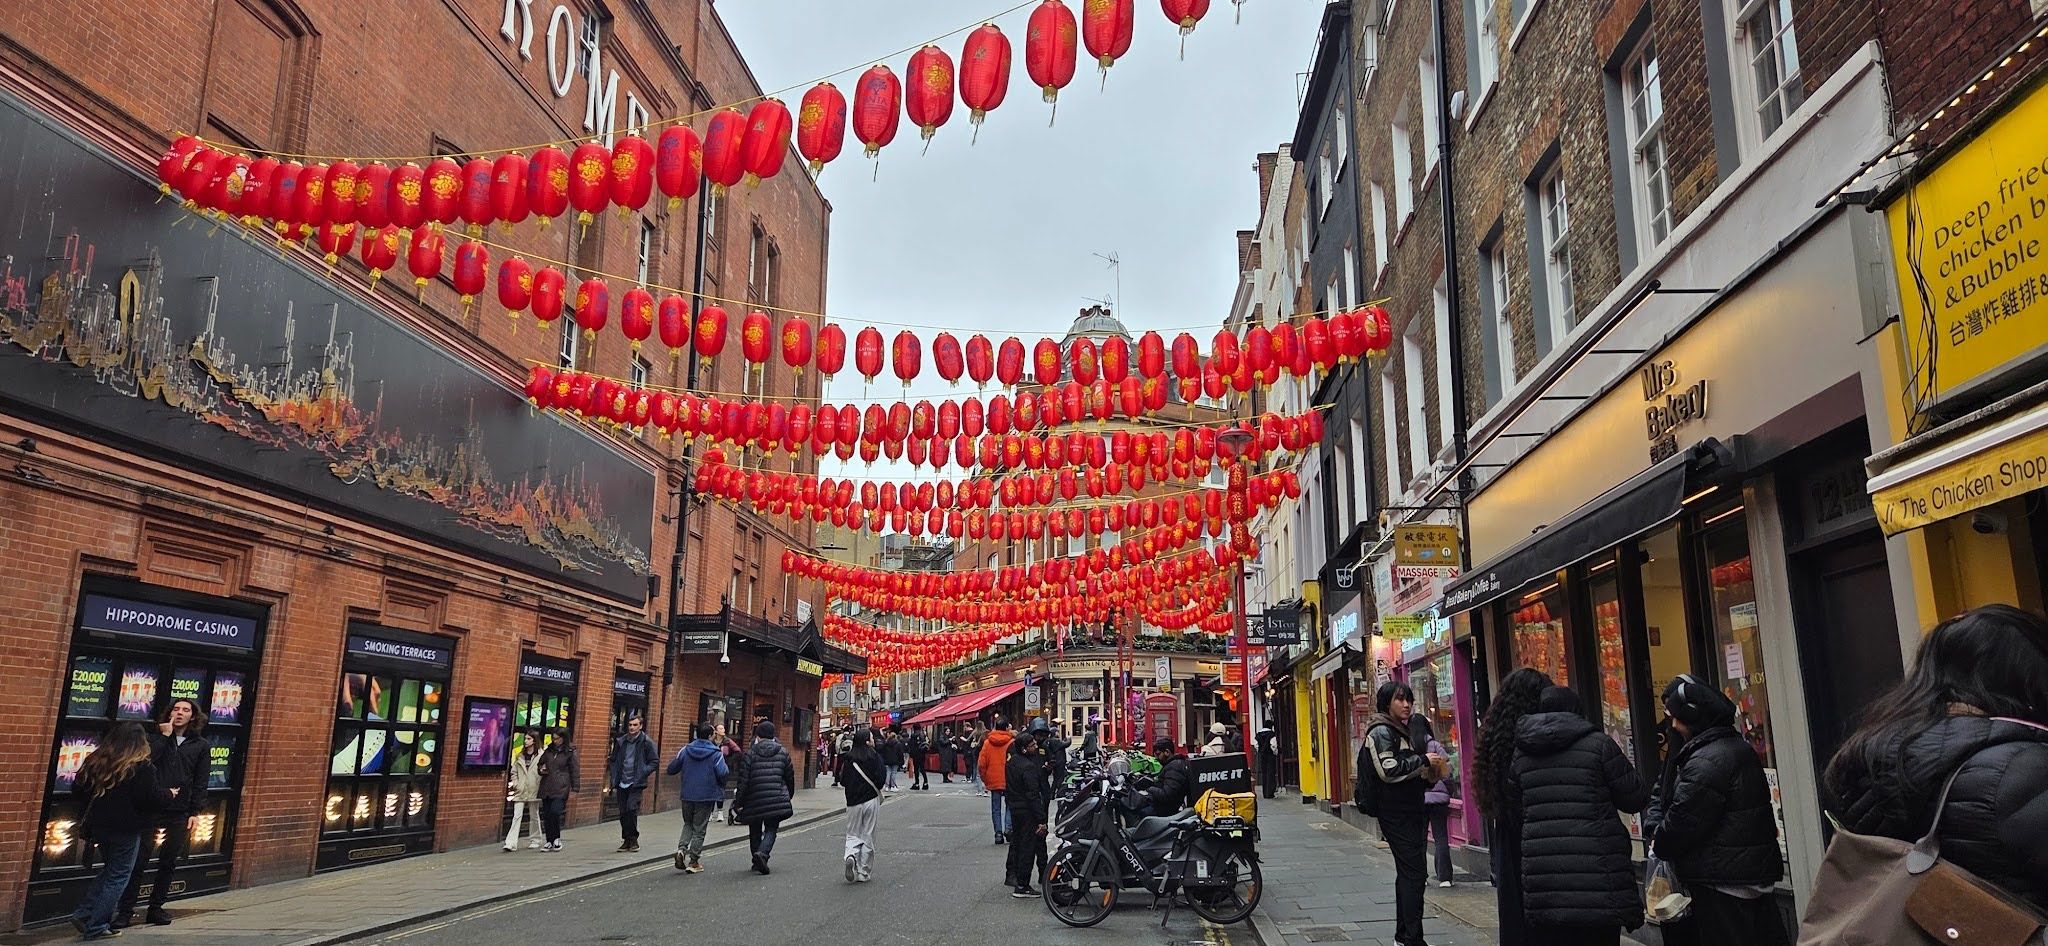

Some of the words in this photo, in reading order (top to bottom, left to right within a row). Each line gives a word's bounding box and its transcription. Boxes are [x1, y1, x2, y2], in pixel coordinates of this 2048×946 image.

[1934, 200, 1990, 250] Deep
[1940, 213, 2023, 278] chicken
[1944, 239, 2040, 309] &Bubble
[1641, 360, 1676, 401] Mrs
[1645, 379, 1707, 441] Bakery
[1900, 496, 1927, 520] The
[1932, 474, 1994, 510] Chicken
[2000, 455, 2048, 487] Shop
[1398, 567, 1439, 578] MASSAGE
[106, 607, 191, 631] HIPPODROME
[195, 620, 238, 637] CASINO
[364, 640, 400, 656] SMOKING
[401, 645, 436, 660] TERRACES
[72, 670, 106, 683] £20,000
[172, 679, 199, 691] £20,000
[524, 665, 528, 674] 8
[528, 666, 542, 675] BARS
[547, 668, 561, 678] OPEN
[615, 681, 628, 690] MAGIC
[1198, 770, 1229, 783] BIKE
[1231, 768, 1243, 779] IT
[1120, 845, 1144, 872] PORT
